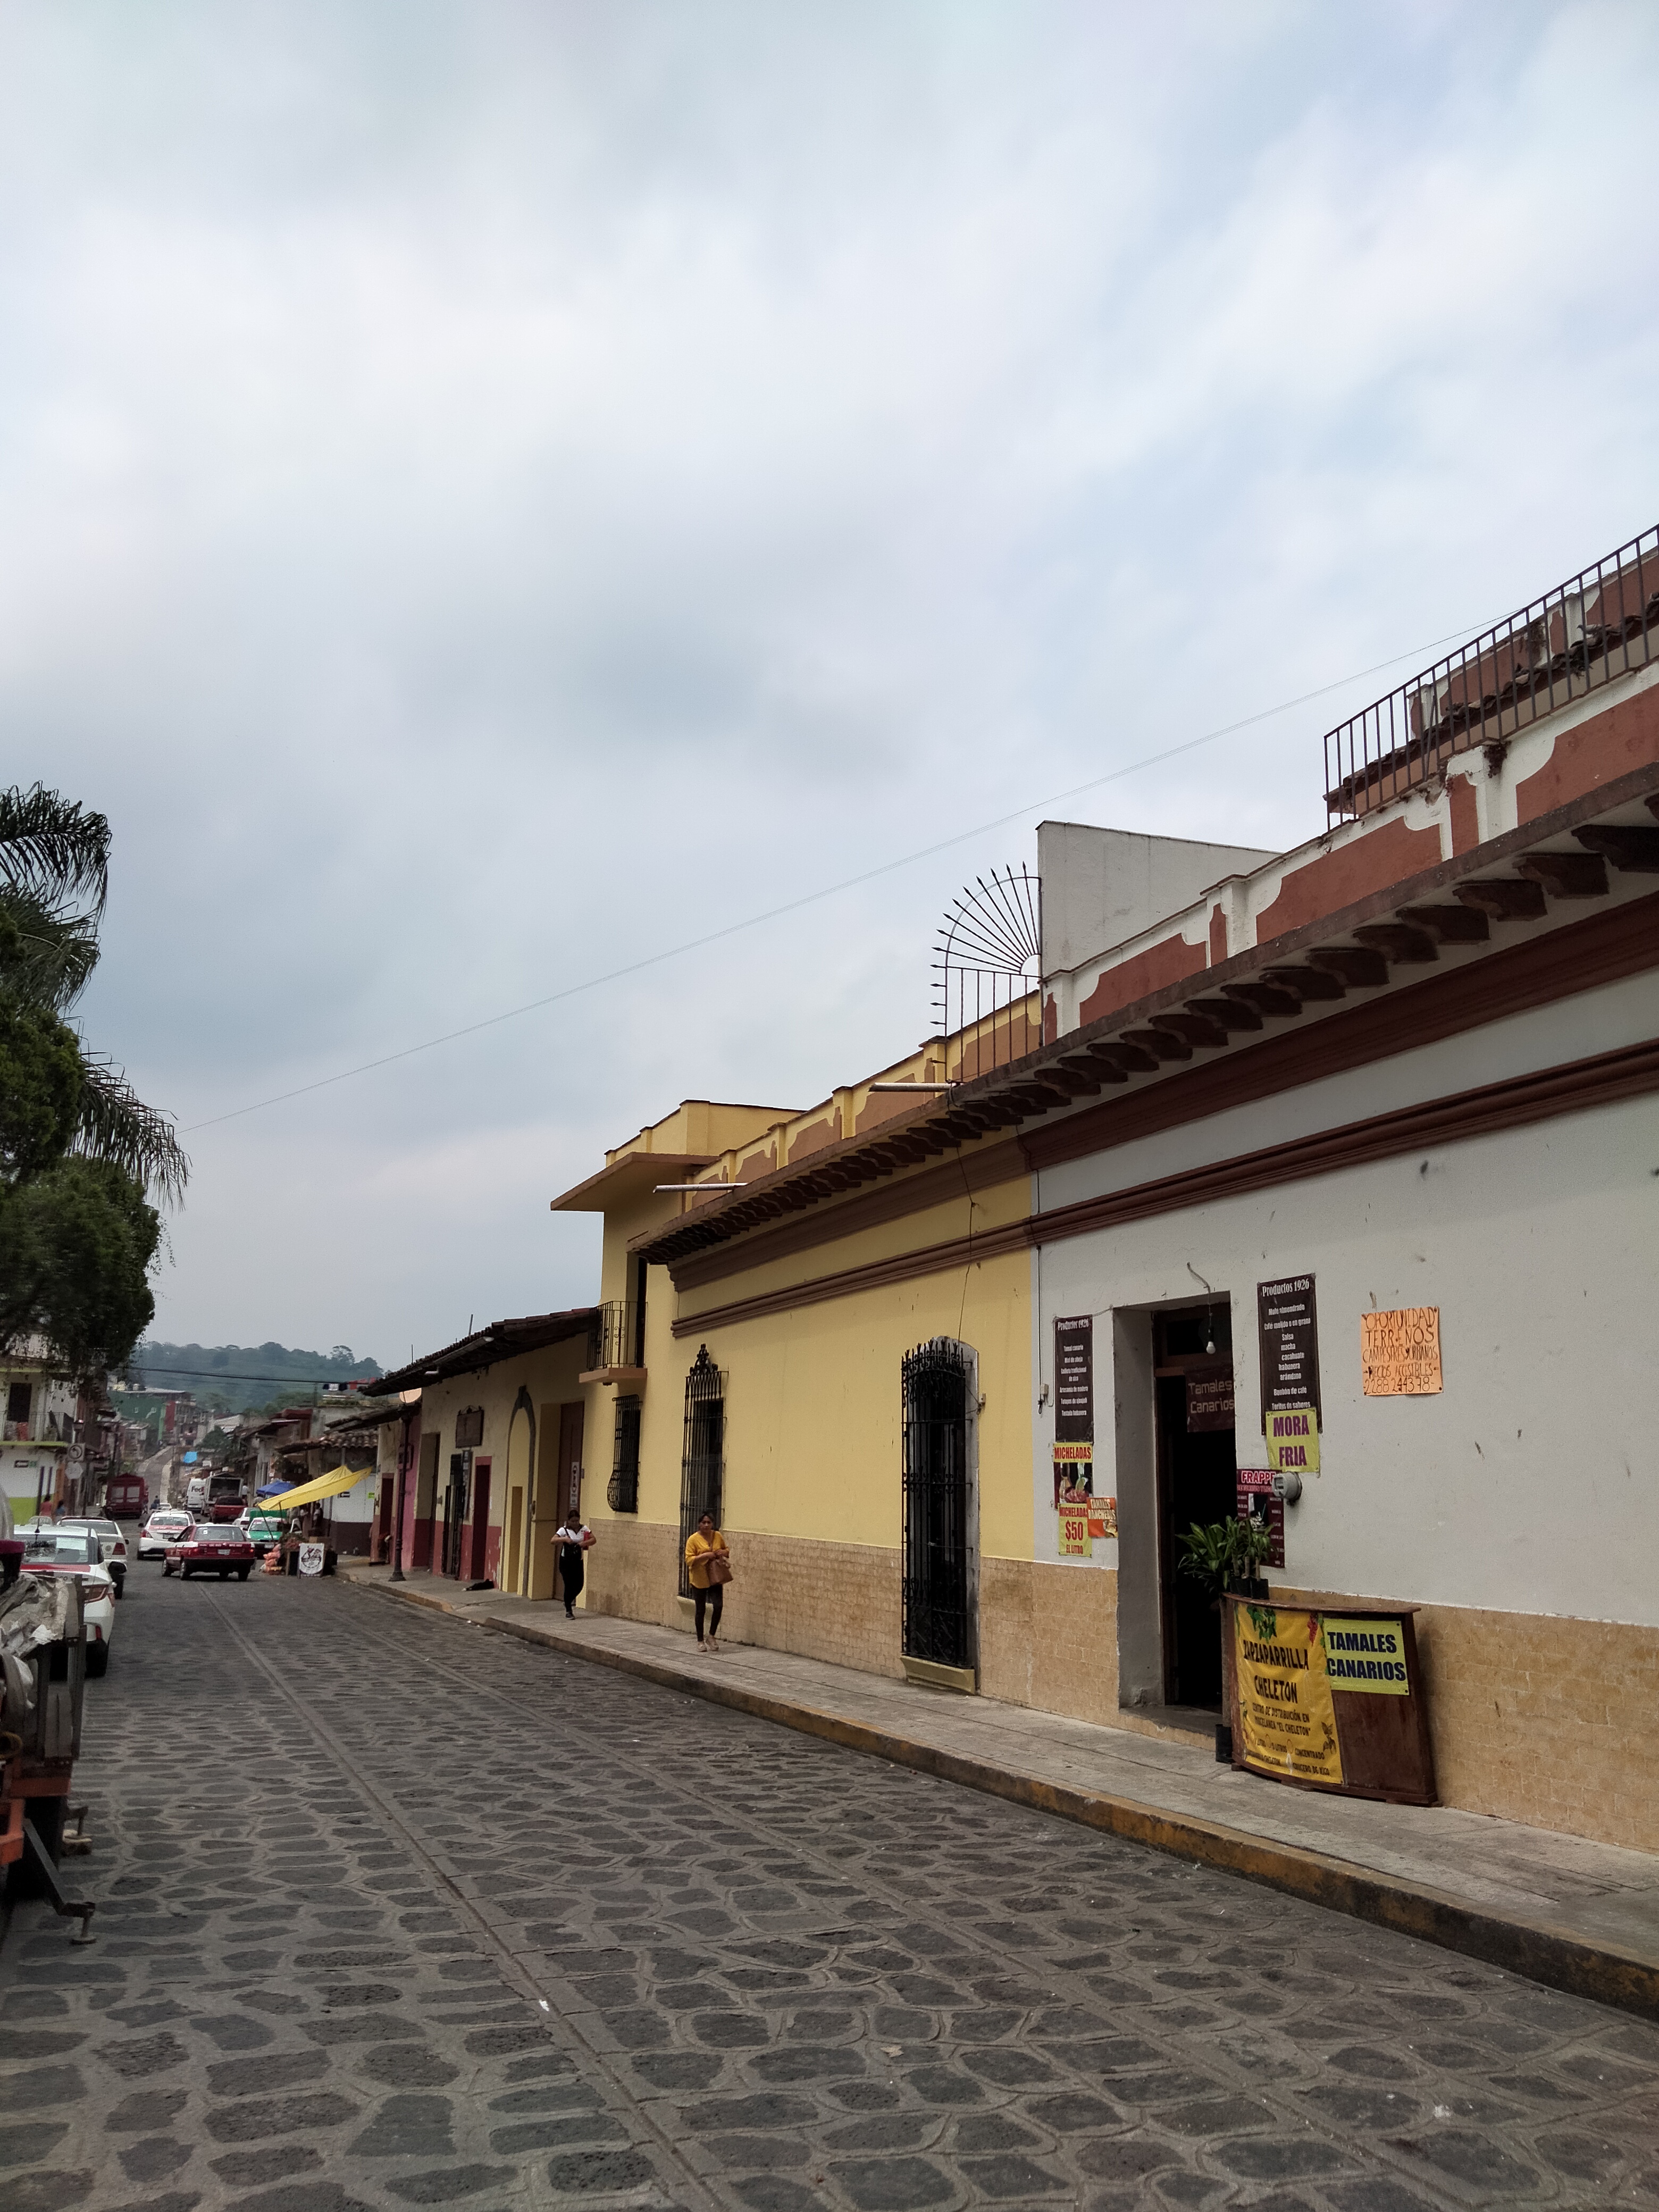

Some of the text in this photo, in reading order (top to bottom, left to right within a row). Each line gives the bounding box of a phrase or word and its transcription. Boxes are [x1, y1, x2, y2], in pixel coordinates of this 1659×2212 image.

[1262, 1278, 1309, 1297] Productos 1926
[1279, 1303, 1305, 1313] almendrado
[1058, 1318, 1089, 1330] Productos 1926
[1298, 1318, 1311, 1326] grano
[1366, 1306, 1435, 1329] OPORTUNIDAD
[1365, 1326, 1434, 1347] TERRENOS
[1281, 1352, 1304, 1361] cacahuate
[1363, 1345, 1405, 1363] CAMPESTRES
[1188, 1379, 1232, 1395] Tamales
[1191, 1397, 1234, 1413] Canarios
[1273, 1415, 1310, 1437] MORA
[1054, 1447, 1092, 1460] MICHELADAS
[1279, 1445, 1307, 1467] FRIA
[1091, 1499, 1111, 1510] TAMALES
[1065, 1520, 1083, 1541] $50
[1066, 1544, 1083, 1555] EL LITRO
[1327, 1632, 1397, 1653] TAMALES
[1243, 1639, 1309, 1670] ZARZAPARRILLA
[1327, 1658, 1406, 1681] CANARIOS
[1254, 1675, 1298, 1704] CHELETON
[1266, 1706, 1270, 1716] DE
[1302, 1713, 1310, 1723] EN
